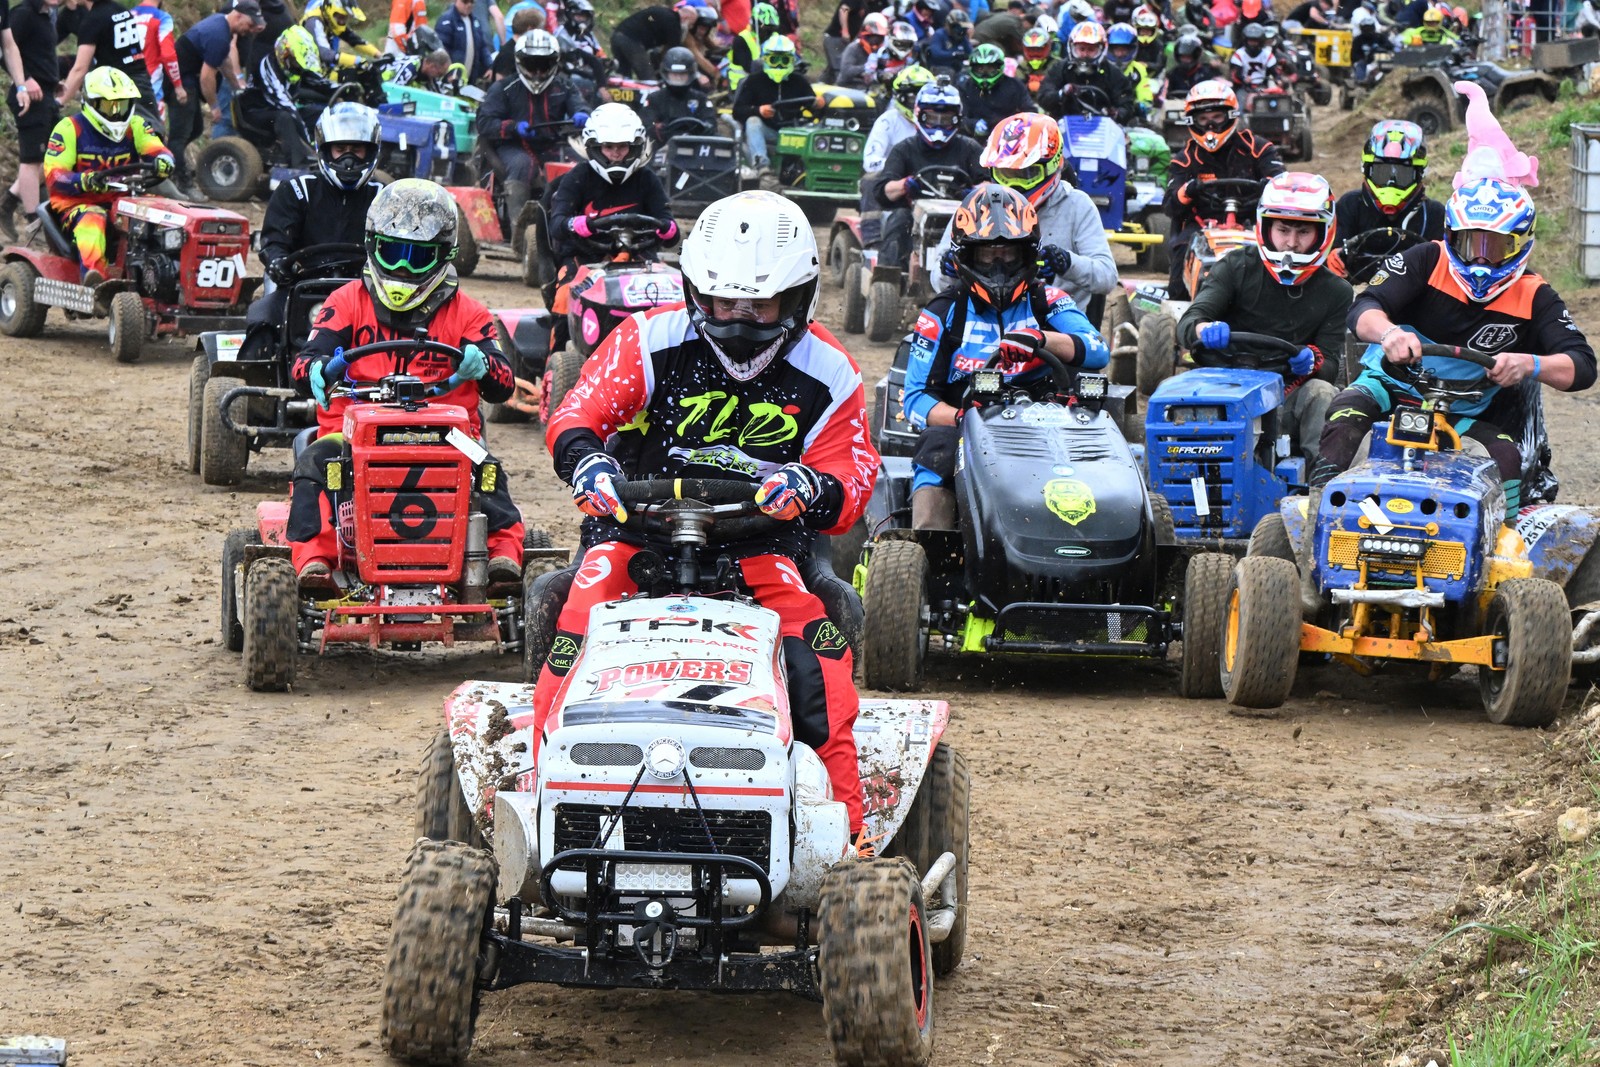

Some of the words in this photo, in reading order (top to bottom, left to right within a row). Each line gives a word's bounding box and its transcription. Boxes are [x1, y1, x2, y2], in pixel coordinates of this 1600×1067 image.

[197, 259, 235, 288] 80
[389, 464, 438, 540] 6
[595, 660, 754, 692] POWERS
